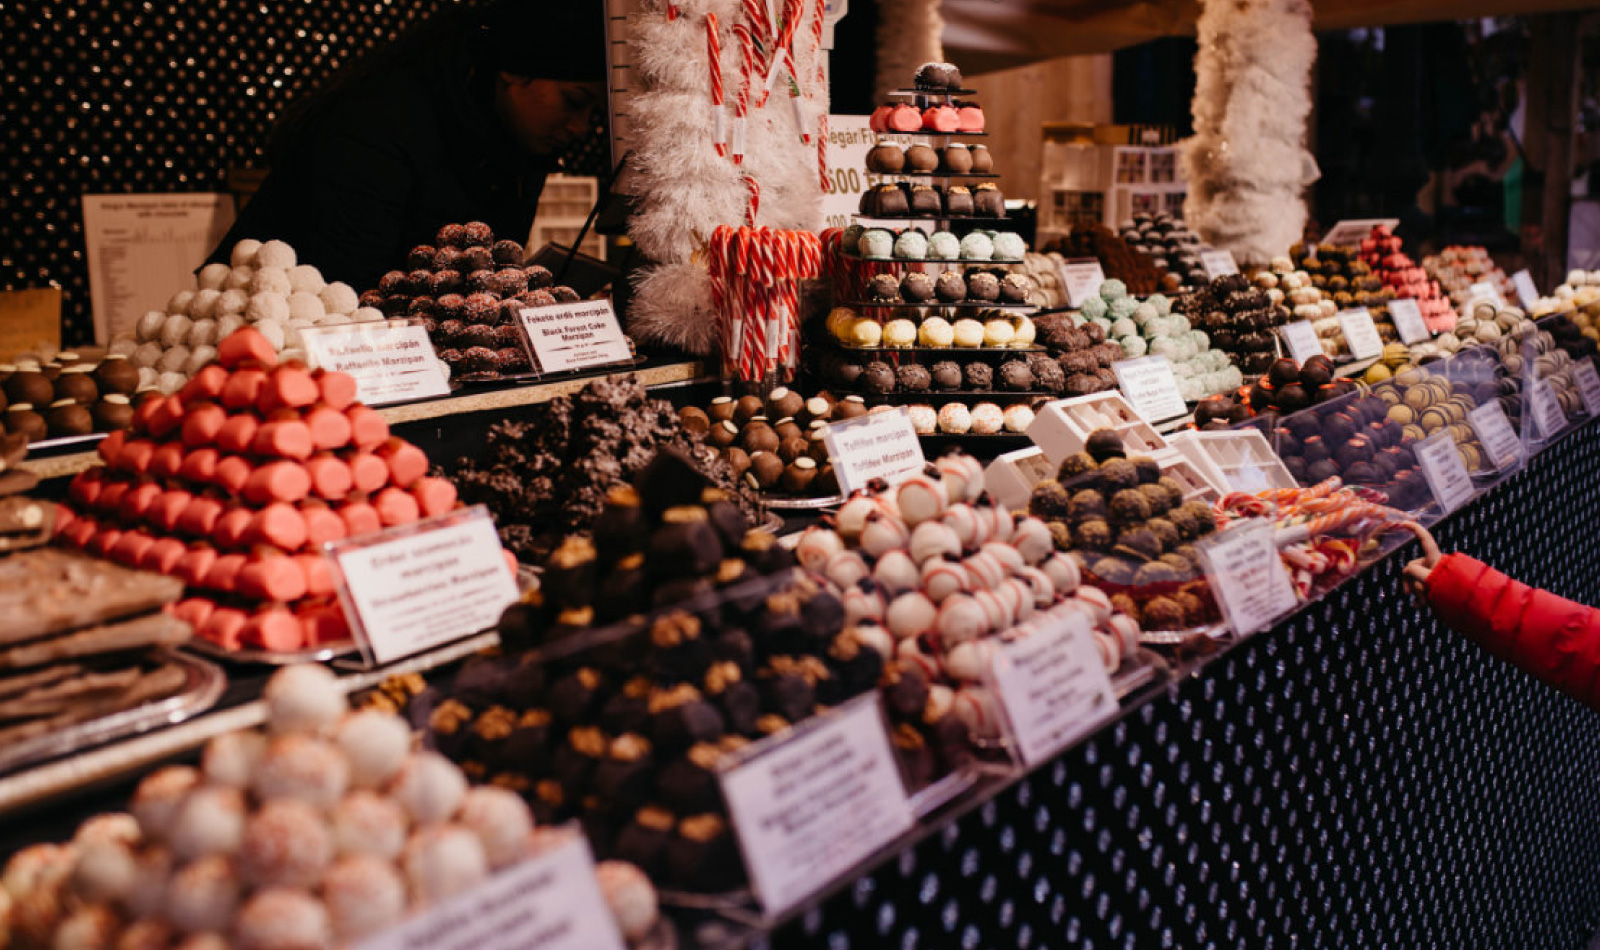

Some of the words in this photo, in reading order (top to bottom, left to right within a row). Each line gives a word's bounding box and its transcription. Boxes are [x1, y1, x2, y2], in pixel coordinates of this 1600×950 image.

[526, 315, 554, 324] Fekete
[541, 327, 562, 337] Black
[564, 324, 586, 334] Forest
[587, 322, 607, 331] Cake
